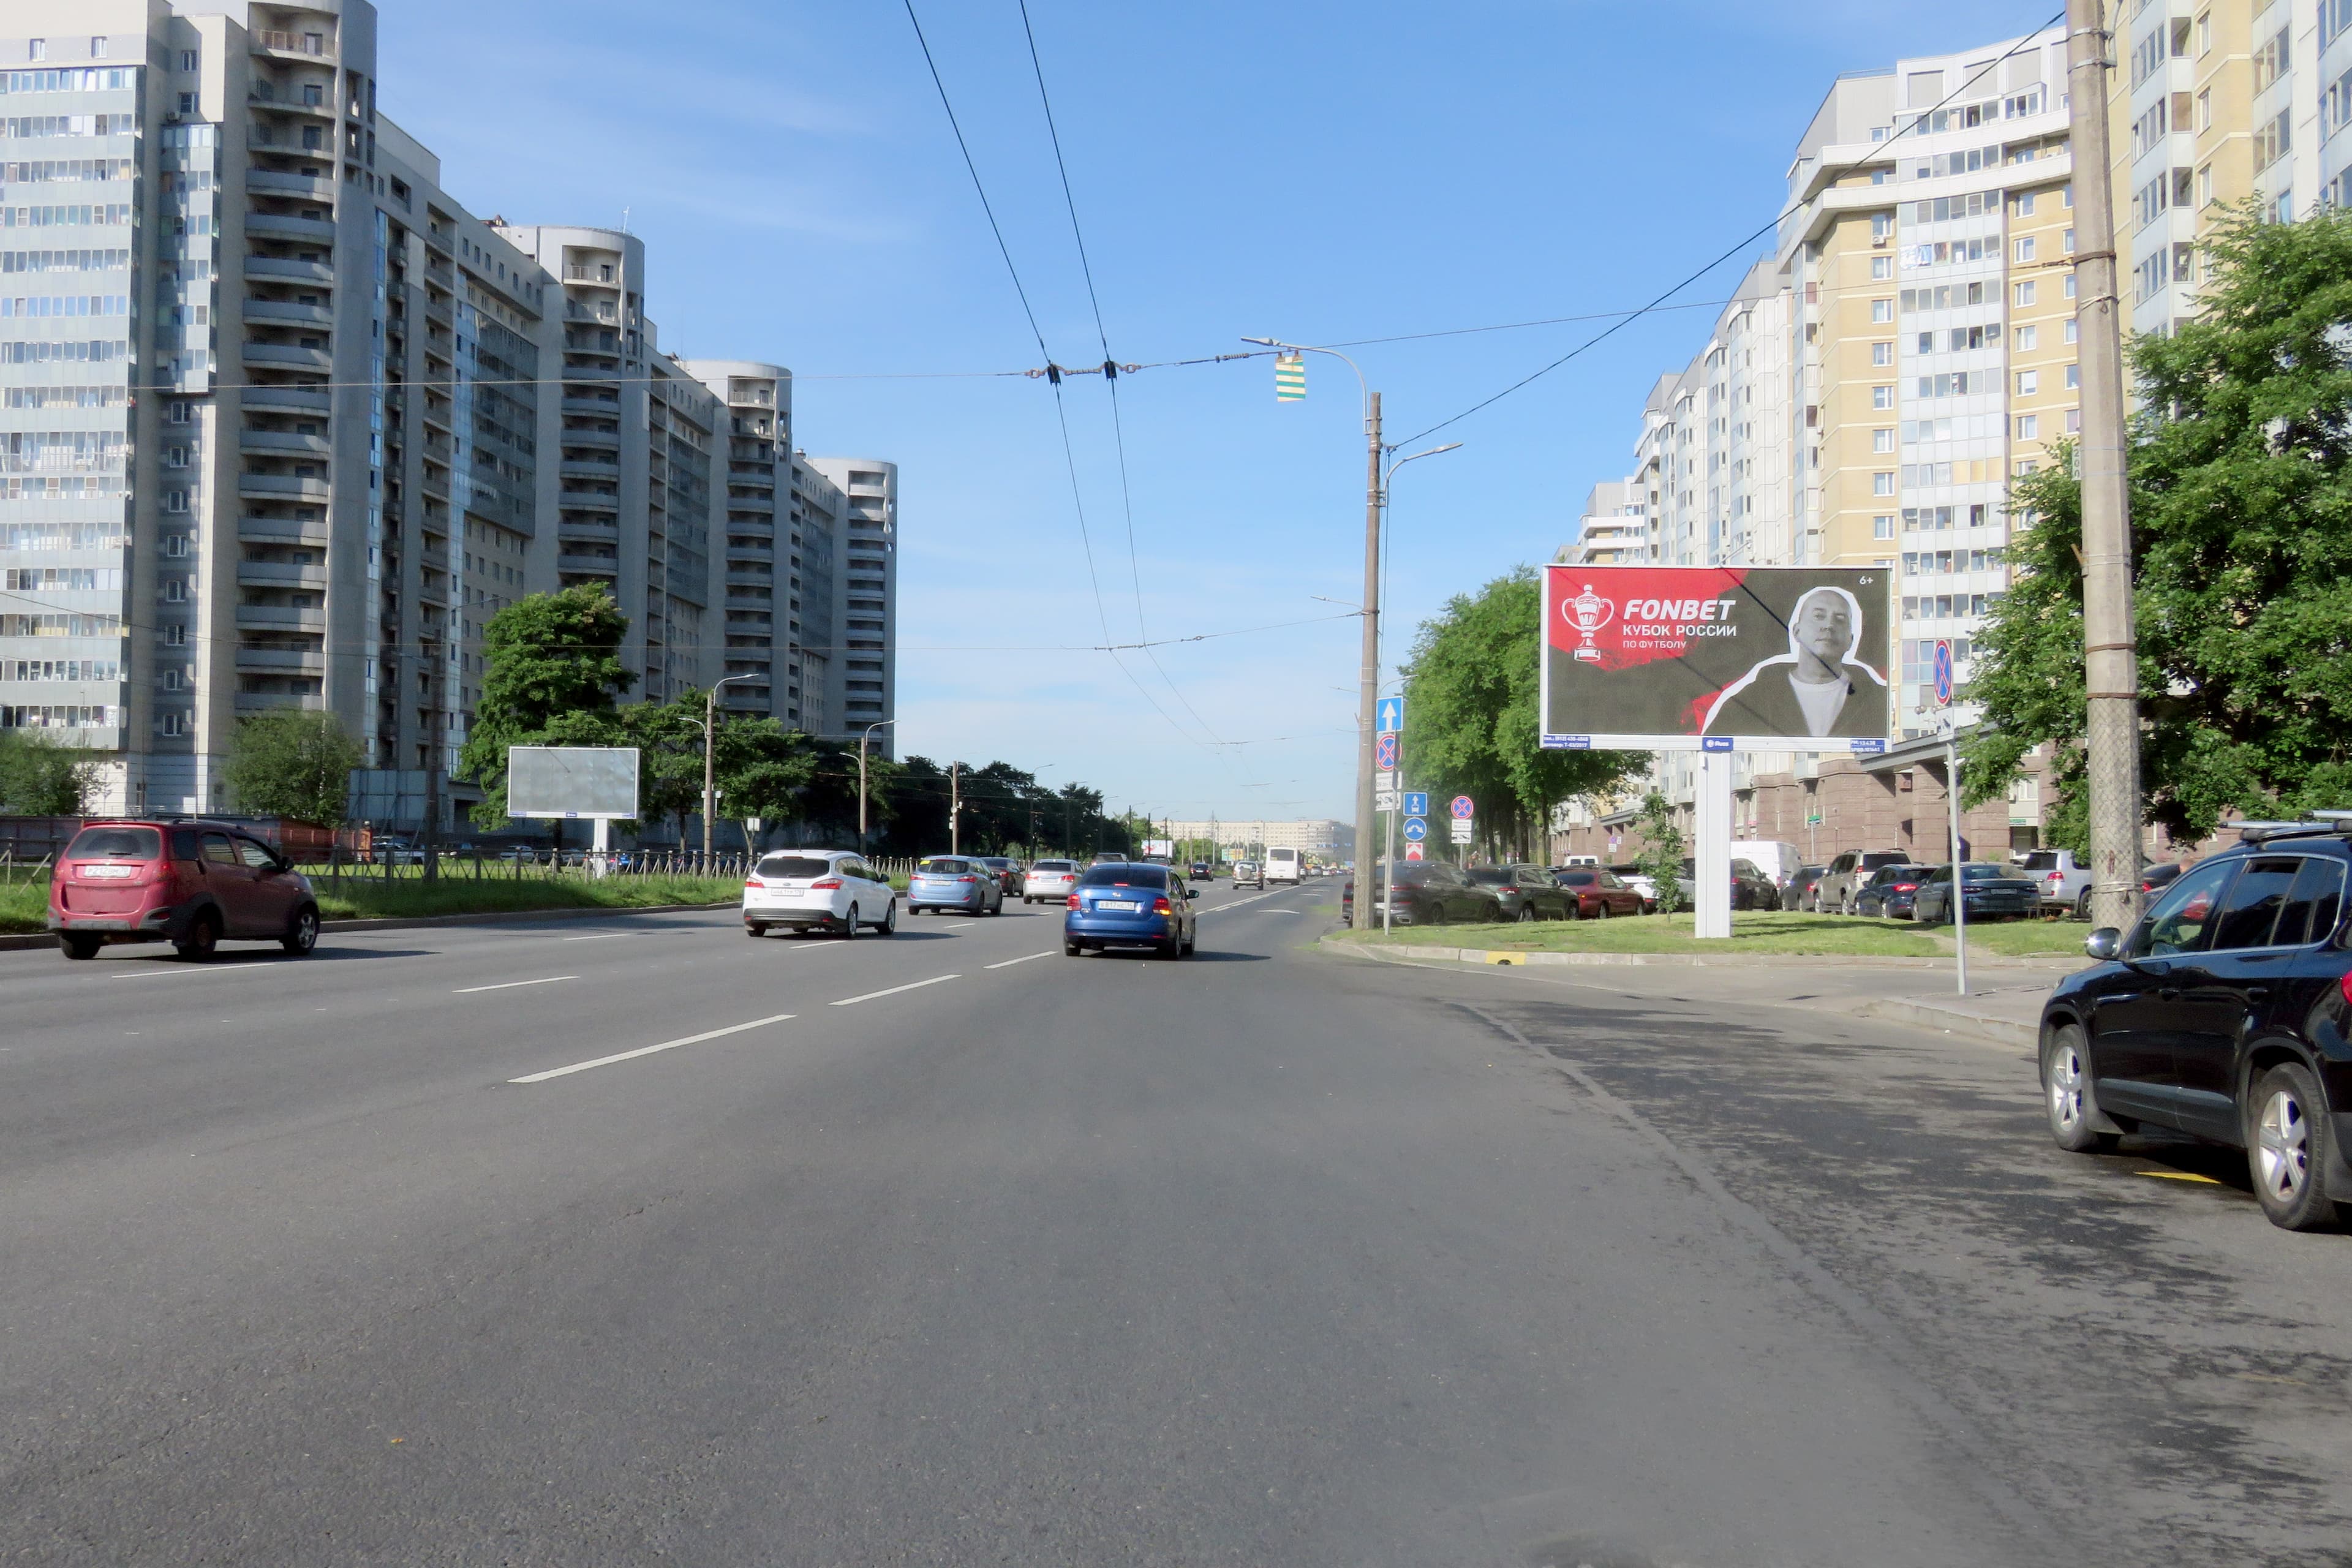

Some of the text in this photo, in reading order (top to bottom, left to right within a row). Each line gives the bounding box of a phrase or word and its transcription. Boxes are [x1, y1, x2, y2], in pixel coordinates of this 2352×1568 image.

[1860, 576, 1874, 584] 6+
[1624, 600, 1736, 620] FONBET
[1623, 625, 1736, 636] КУБОК РОССИИ
